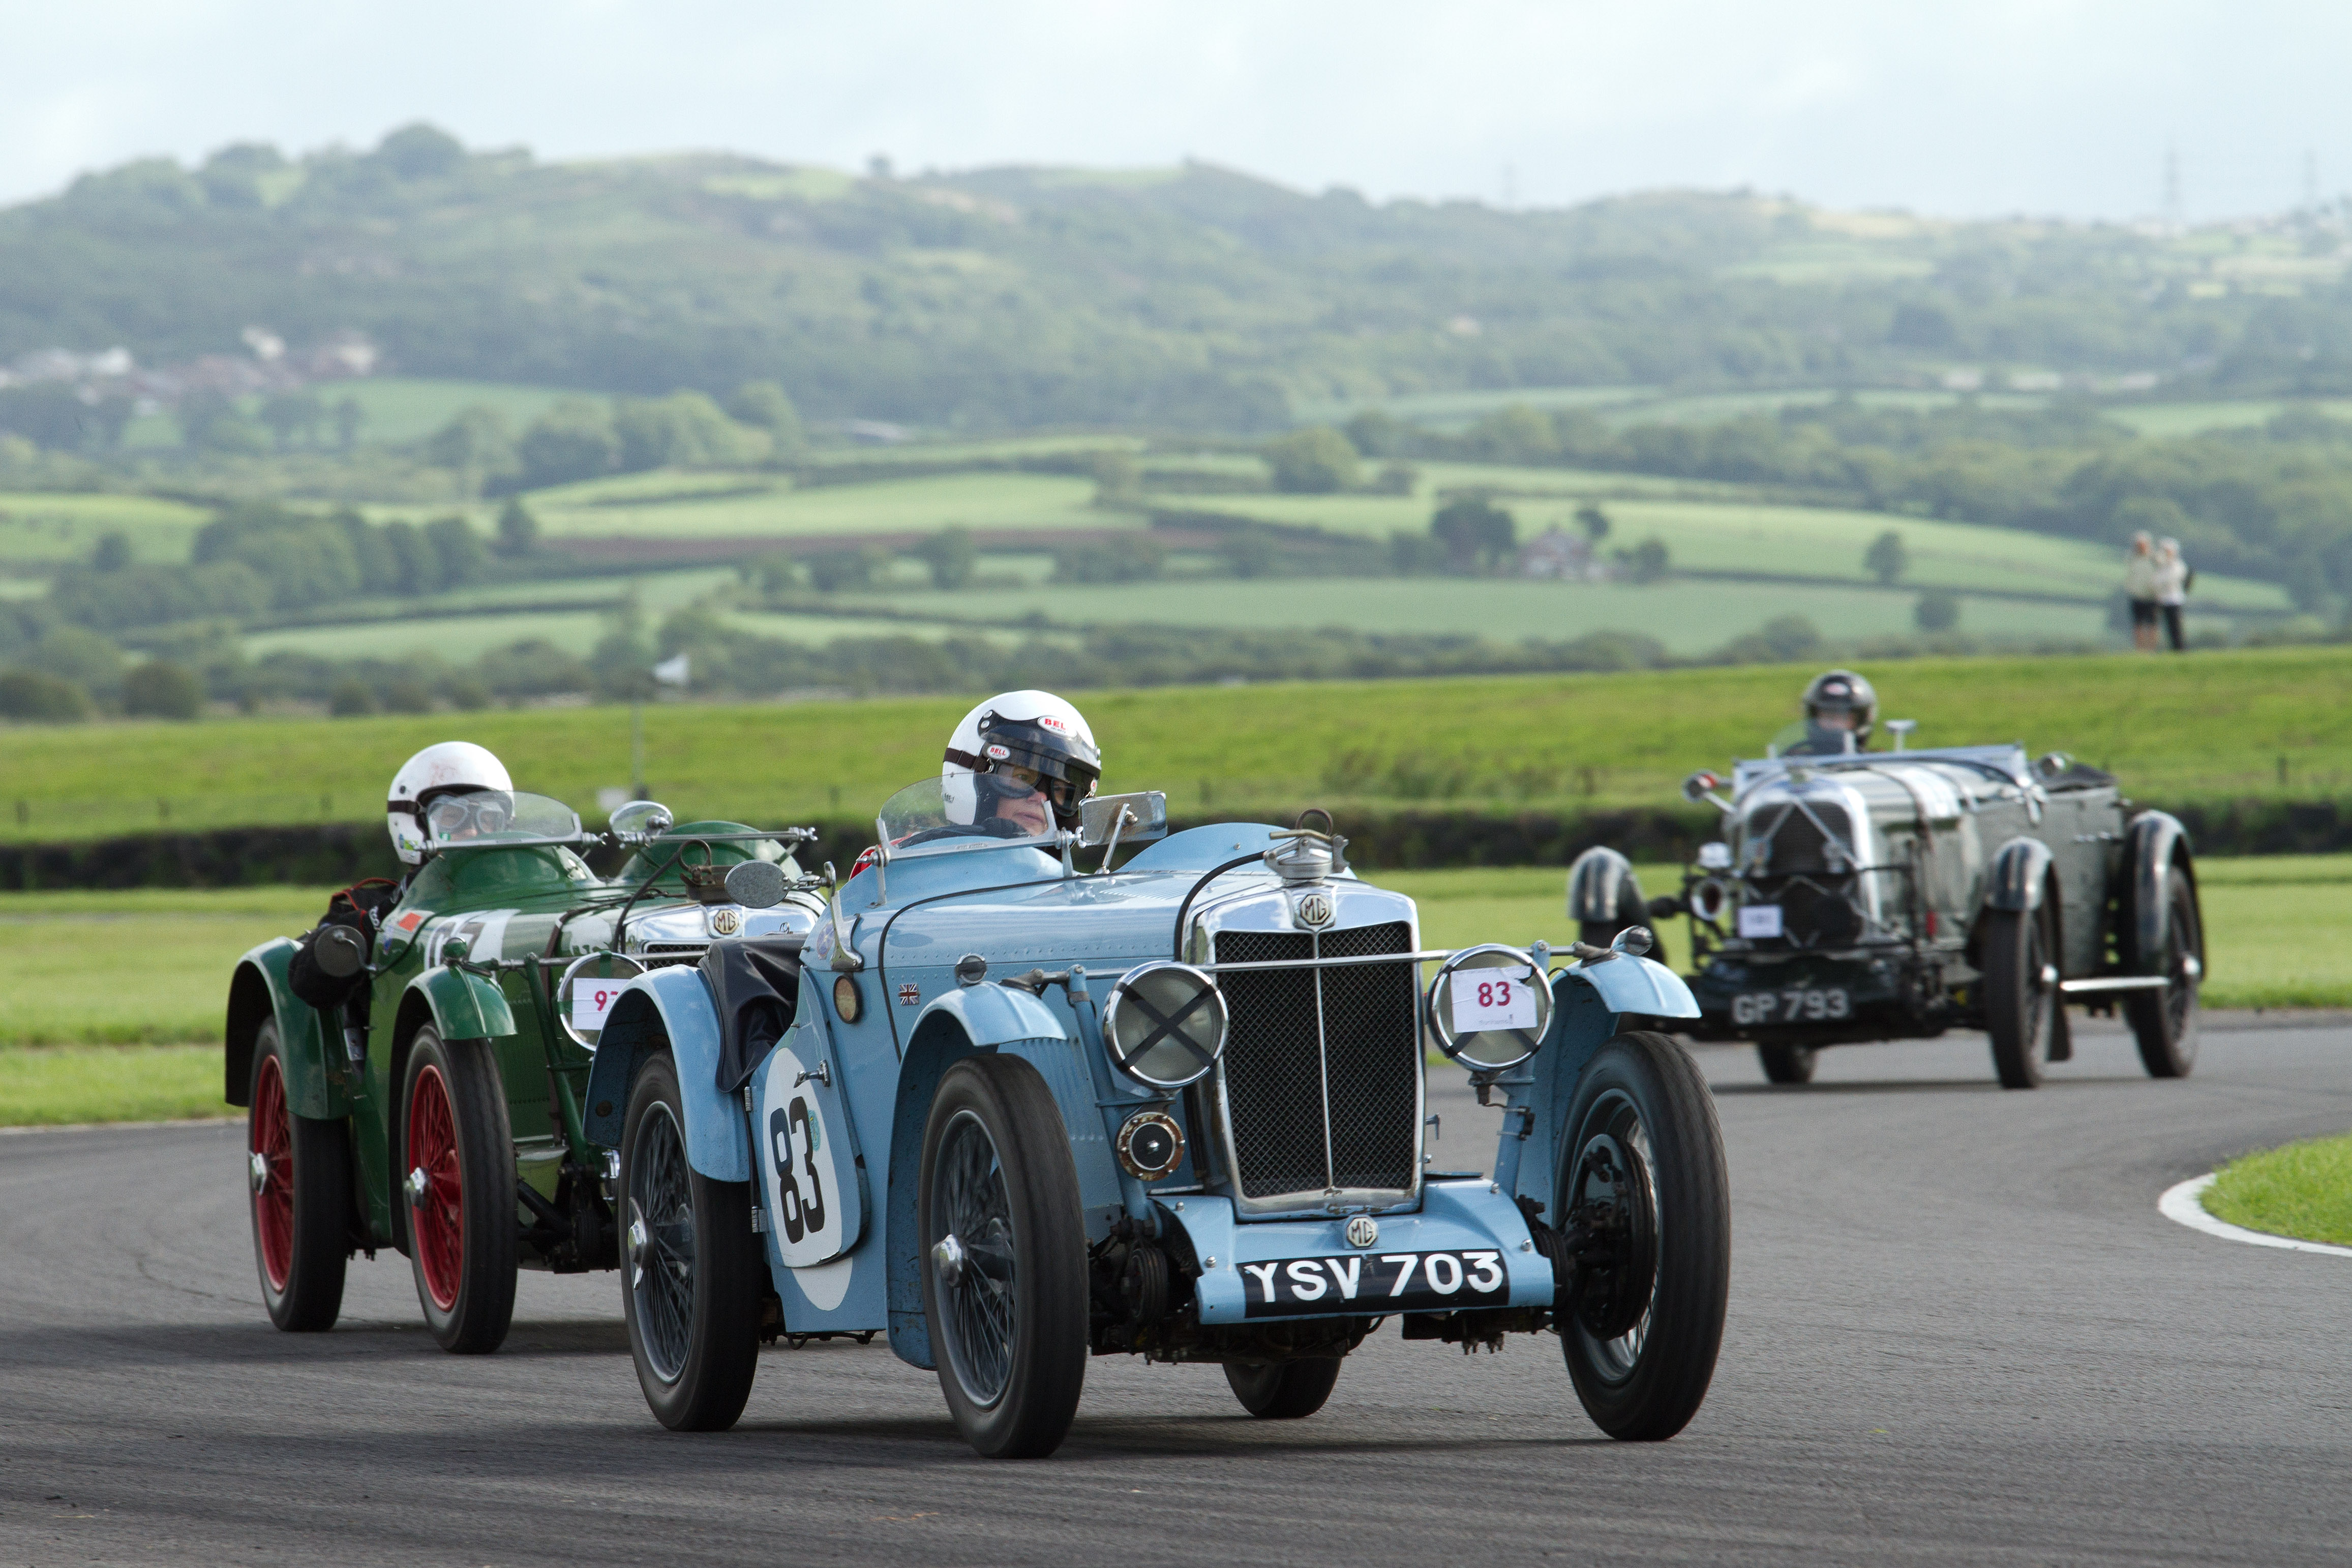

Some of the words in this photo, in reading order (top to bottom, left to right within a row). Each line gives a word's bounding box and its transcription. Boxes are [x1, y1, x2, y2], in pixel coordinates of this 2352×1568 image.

[1044, 718, 1069, 731] BEL
[990, 747, 1006, 756] BELL
[717, 912, 736, 932] MG
[1305, 897, 1328, 922] MG
[1477, 981, 1511, 1007] 83
[1732, 992, 1778, 1024] GP
[1781, 988, 1851, 1021] 793
[770, 1096, 825, 1245] 83
[1350, 1220, 1374, 1245] MG
[1243, 1257, 1361, 1303] YSV
[1380, 1251, 1503, 1295] 703
